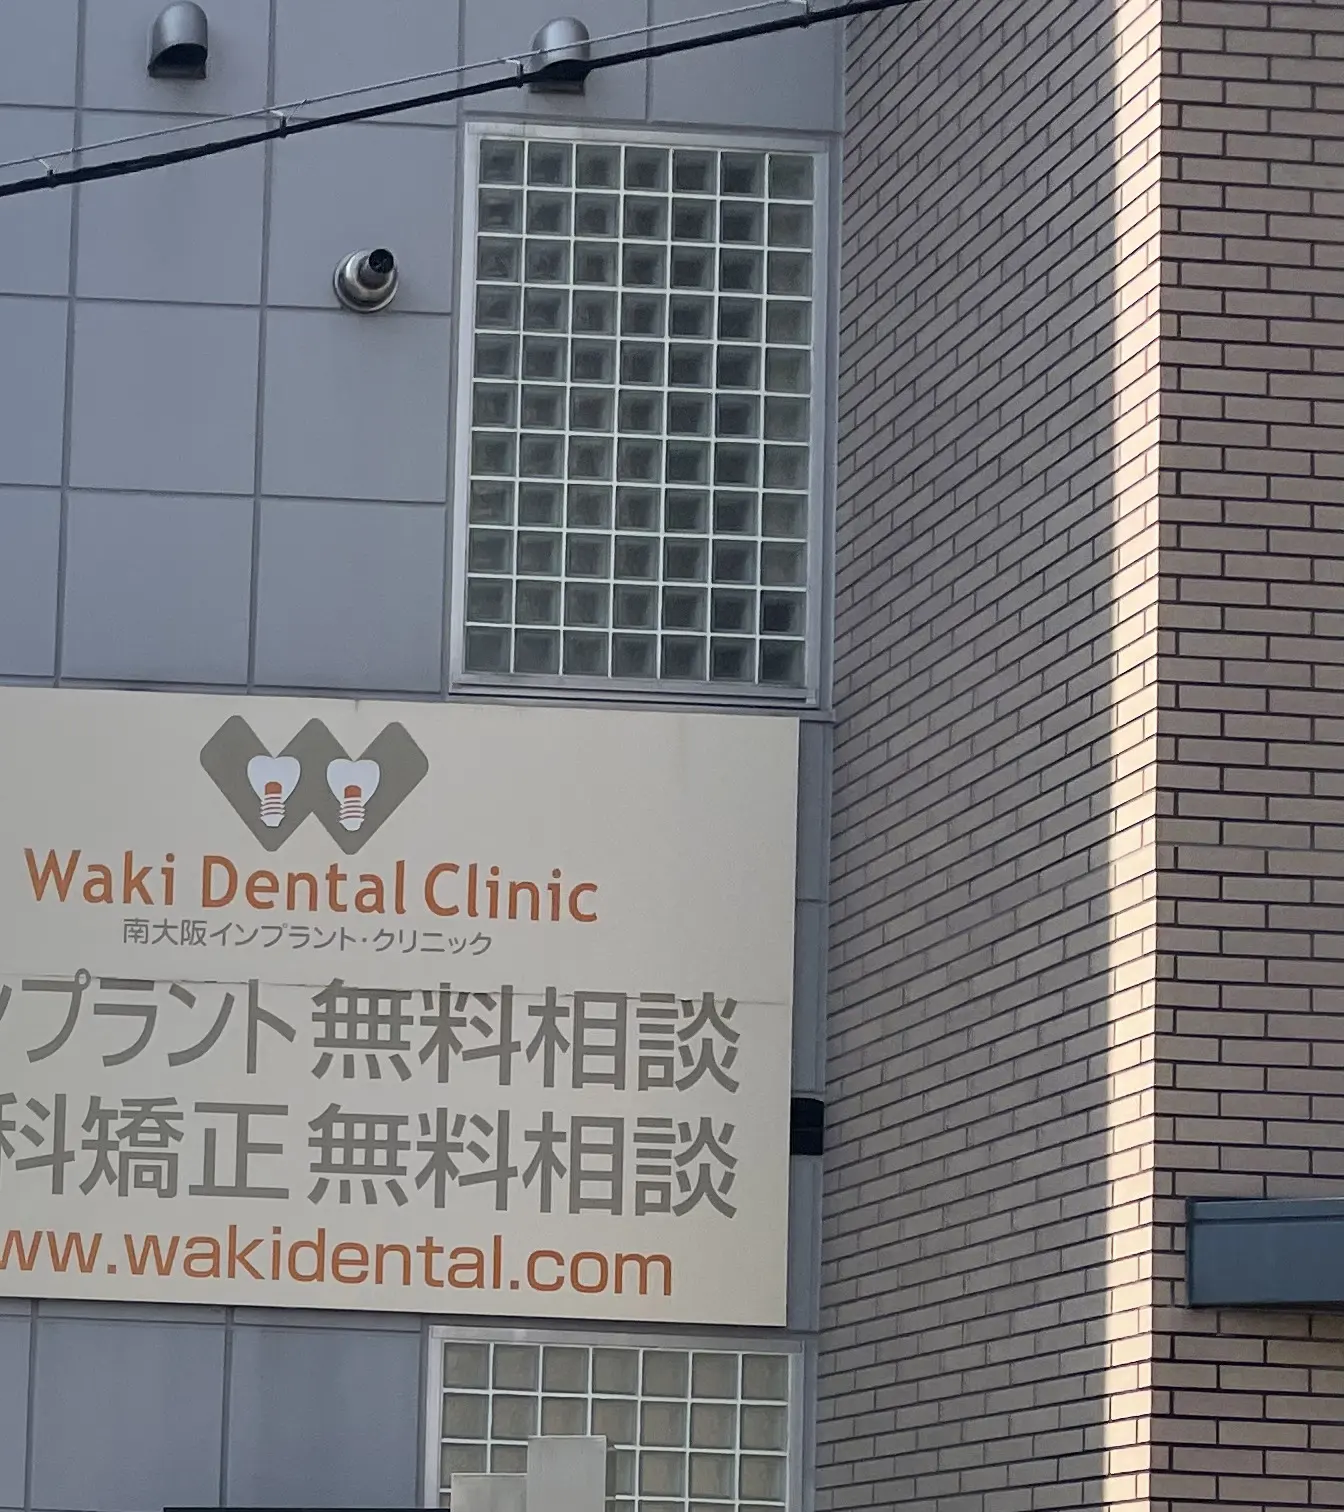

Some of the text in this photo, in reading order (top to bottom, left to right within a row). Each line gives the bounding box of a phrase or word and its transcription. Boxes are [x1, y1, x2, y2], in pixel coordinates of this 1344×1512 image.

[23, 847, 599, 922] Waki Dental Clinic
[122, 917, 493, 956] 南大阪インプラント・クリニック
